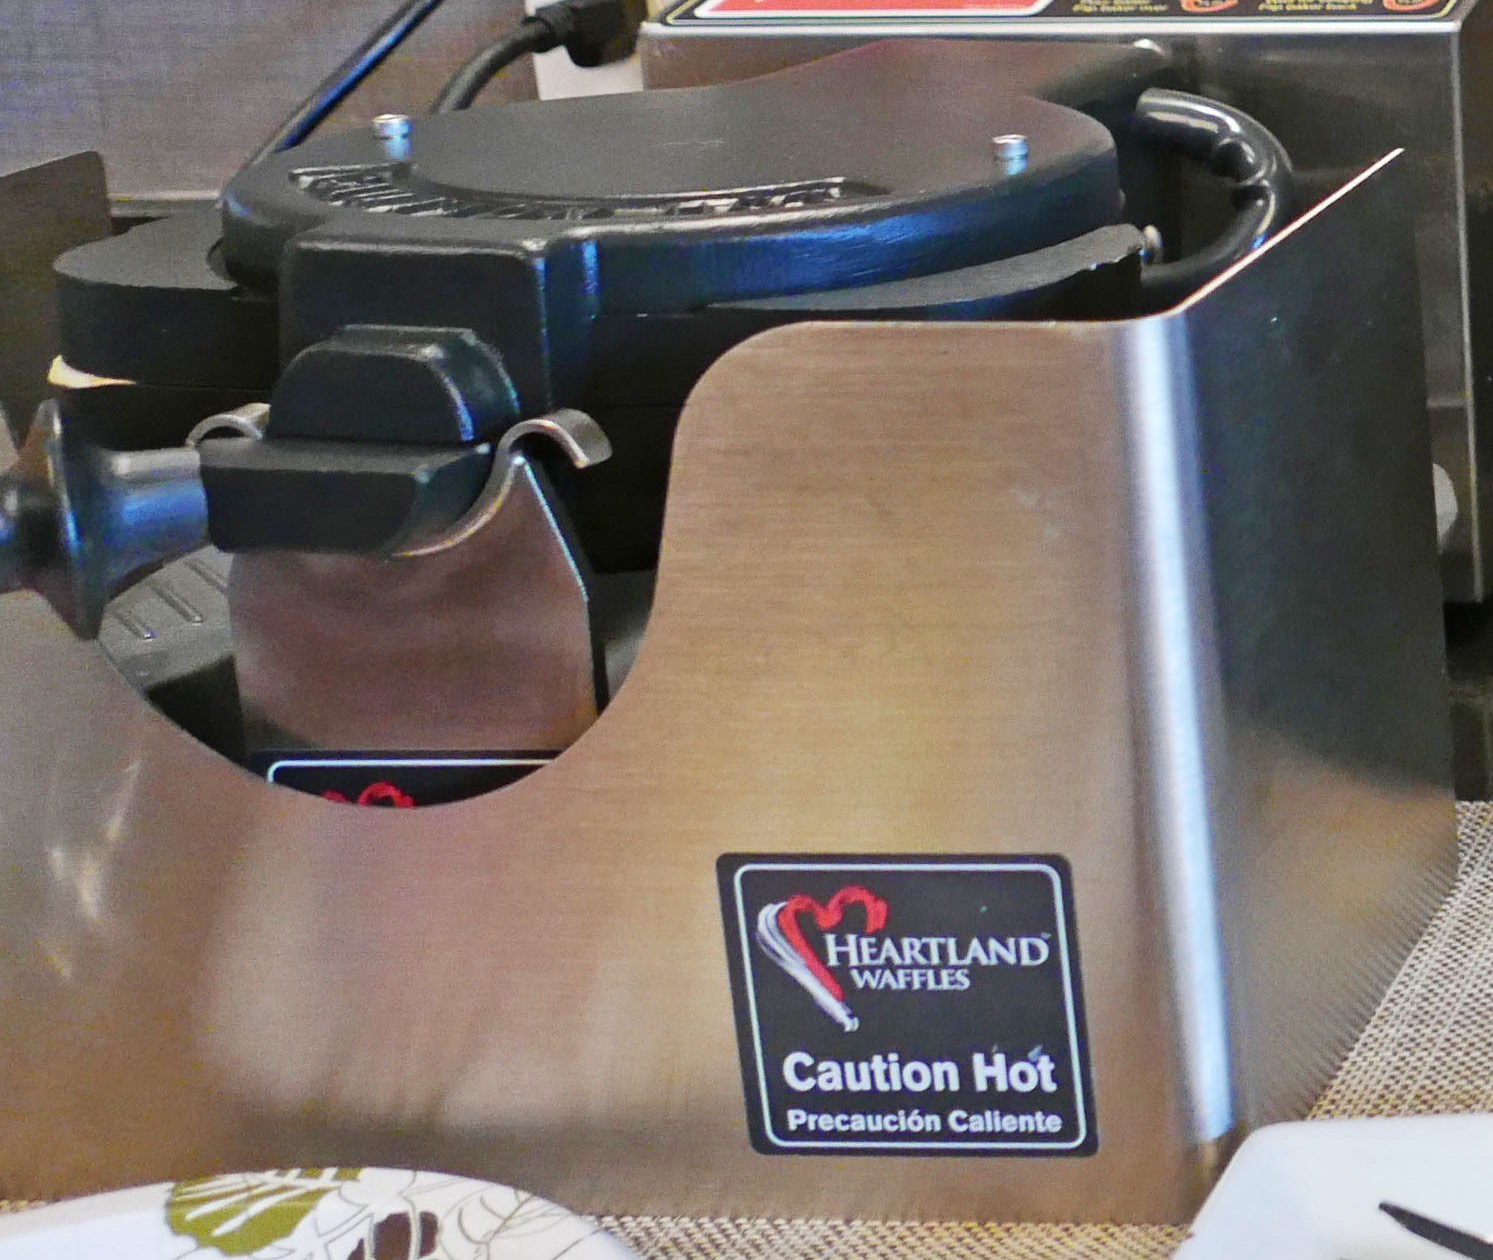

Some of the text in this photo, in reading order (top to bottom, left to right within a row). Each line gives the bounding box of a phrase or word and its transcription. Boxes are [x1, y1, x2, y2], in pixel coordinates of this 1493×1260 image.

[823, 933, 1050, 967] HEARTLAND
[850, 968, 971, 991] WAFFLES
[782, 1051, 1058, 1092] Caution Hot
[786, 1108, 1063, 1134] Precaución Caliente
